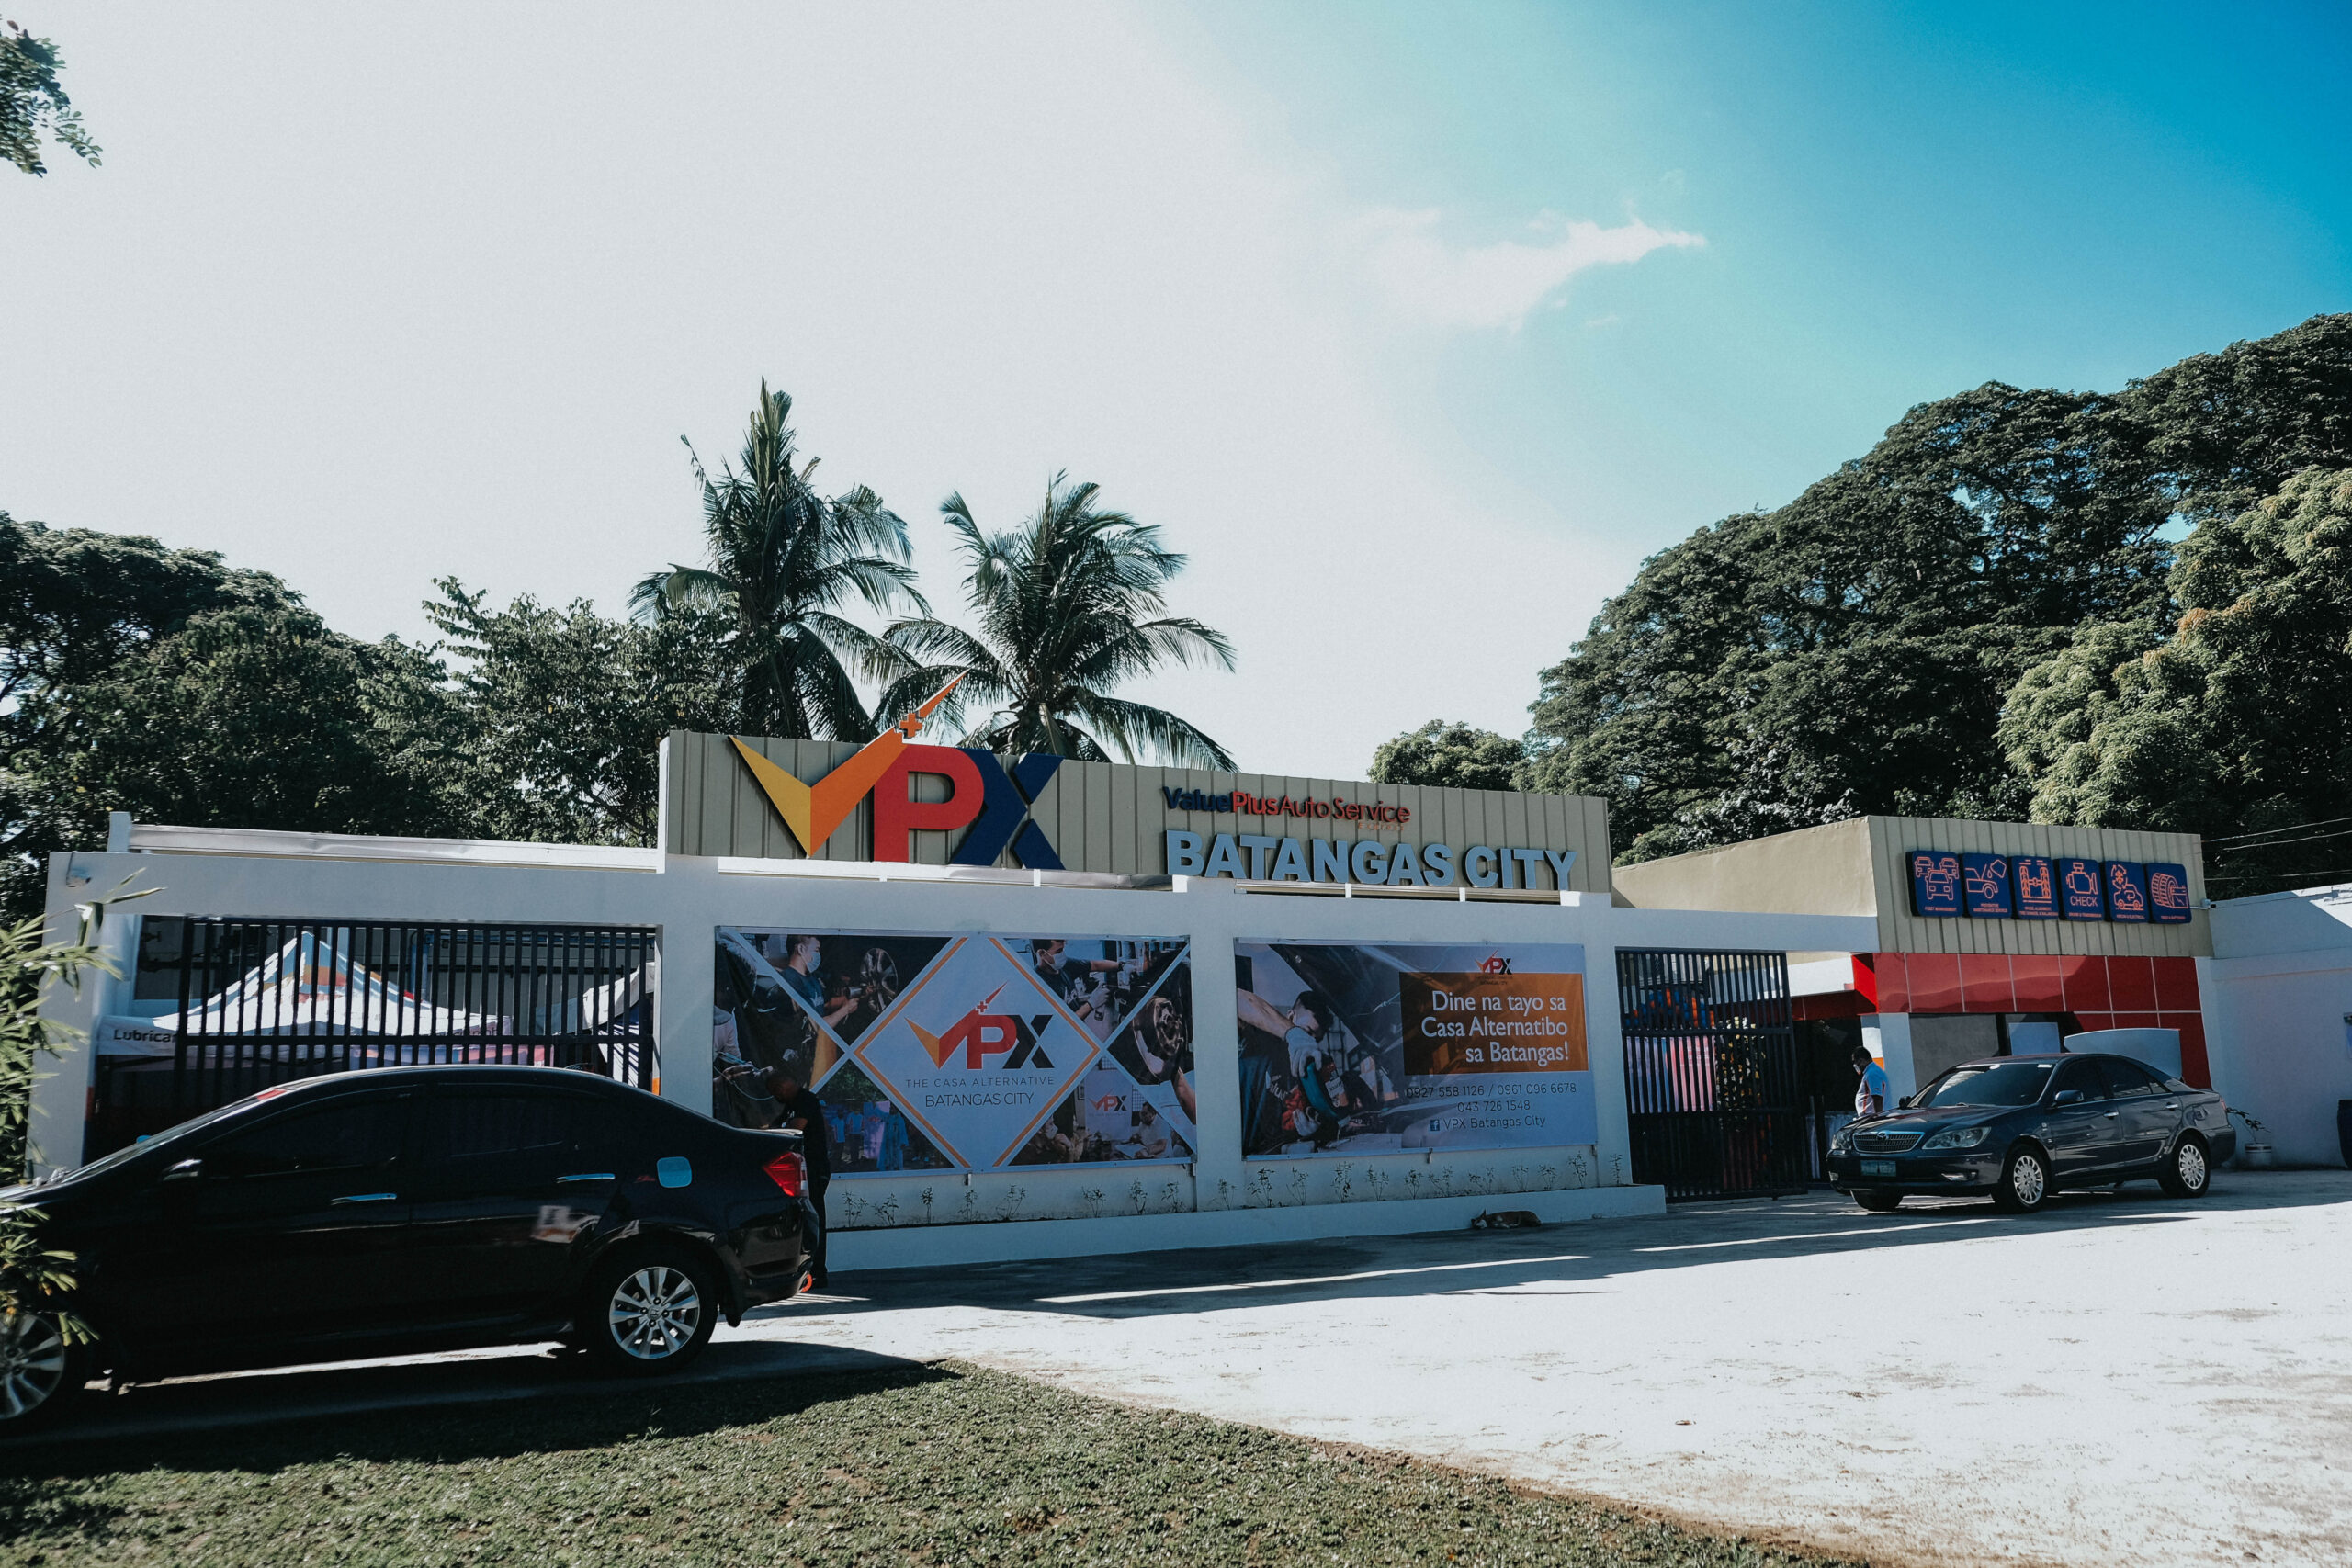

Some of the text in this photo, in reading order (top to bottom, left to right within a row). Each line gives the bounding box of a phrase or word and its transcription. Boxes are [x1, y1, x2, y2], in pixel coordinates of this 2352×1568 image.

[729, 669, 1066, 870] VPX
[1166, 829, 1578, 891] BATANGAS CITY
[2070, 896, 2098, 907] CHECK
[1475, 948, 1512, 976] VPX
[1432, 990, 1566, 1017] Dine na tayo sa
[904, 979, 1055, 1070] VPX
[1421, 1016, 1568, 1037] Casa Alternatibo
[1465, 1041, 1569, 1066] sa Batangas!
[906, 1076, 1056, 1088] THE CASA ALTERNATIVE
[1406, 1082, 1577, 1099] 0927 558 1126 / 0961 096 6678
[925, 1091, 1035, 1108] BATANGAS CITY
[1089, 1089, 1127, 1111] VPX
[1457, 1100, 1531, 1113] 043 726 1548
[1443, 1118, 1466, 1131] VPX
[1470, 1115, 1521, 1129] Batangas
[1524, 1114, 1546, 1129] City
